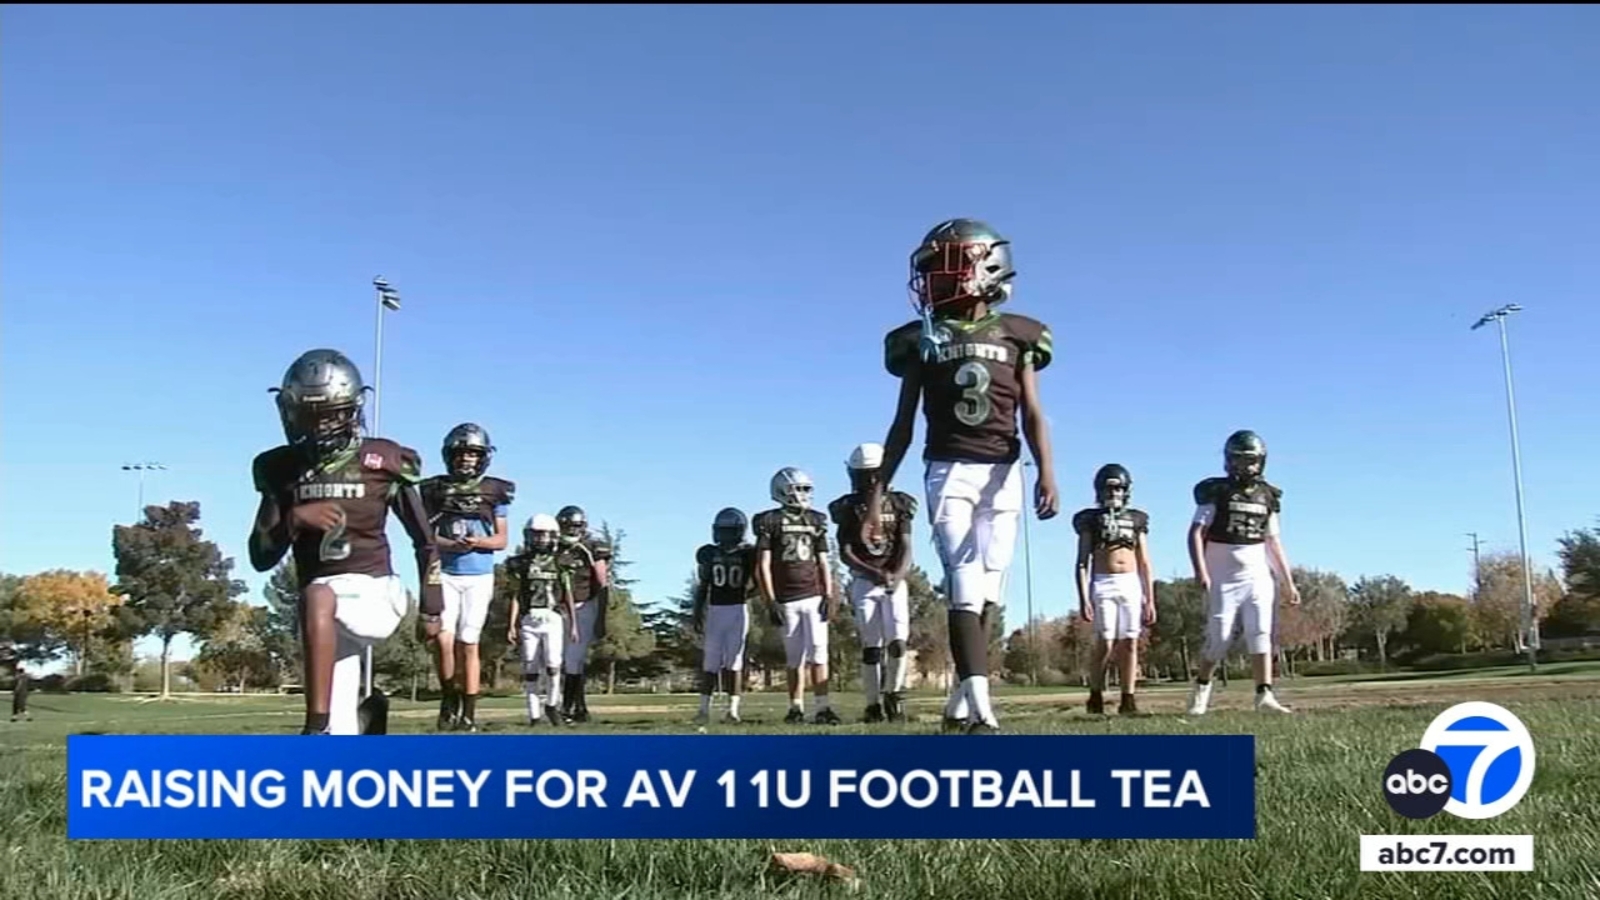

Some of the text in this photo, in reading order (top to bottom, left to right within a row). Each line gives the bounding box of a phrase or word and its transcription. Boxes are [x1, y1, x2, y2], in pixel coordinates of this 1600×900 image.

[954, 361, 990, 426] 3
[320, 502, 350, 561] 2
[712, 563, 744, 588] 00
